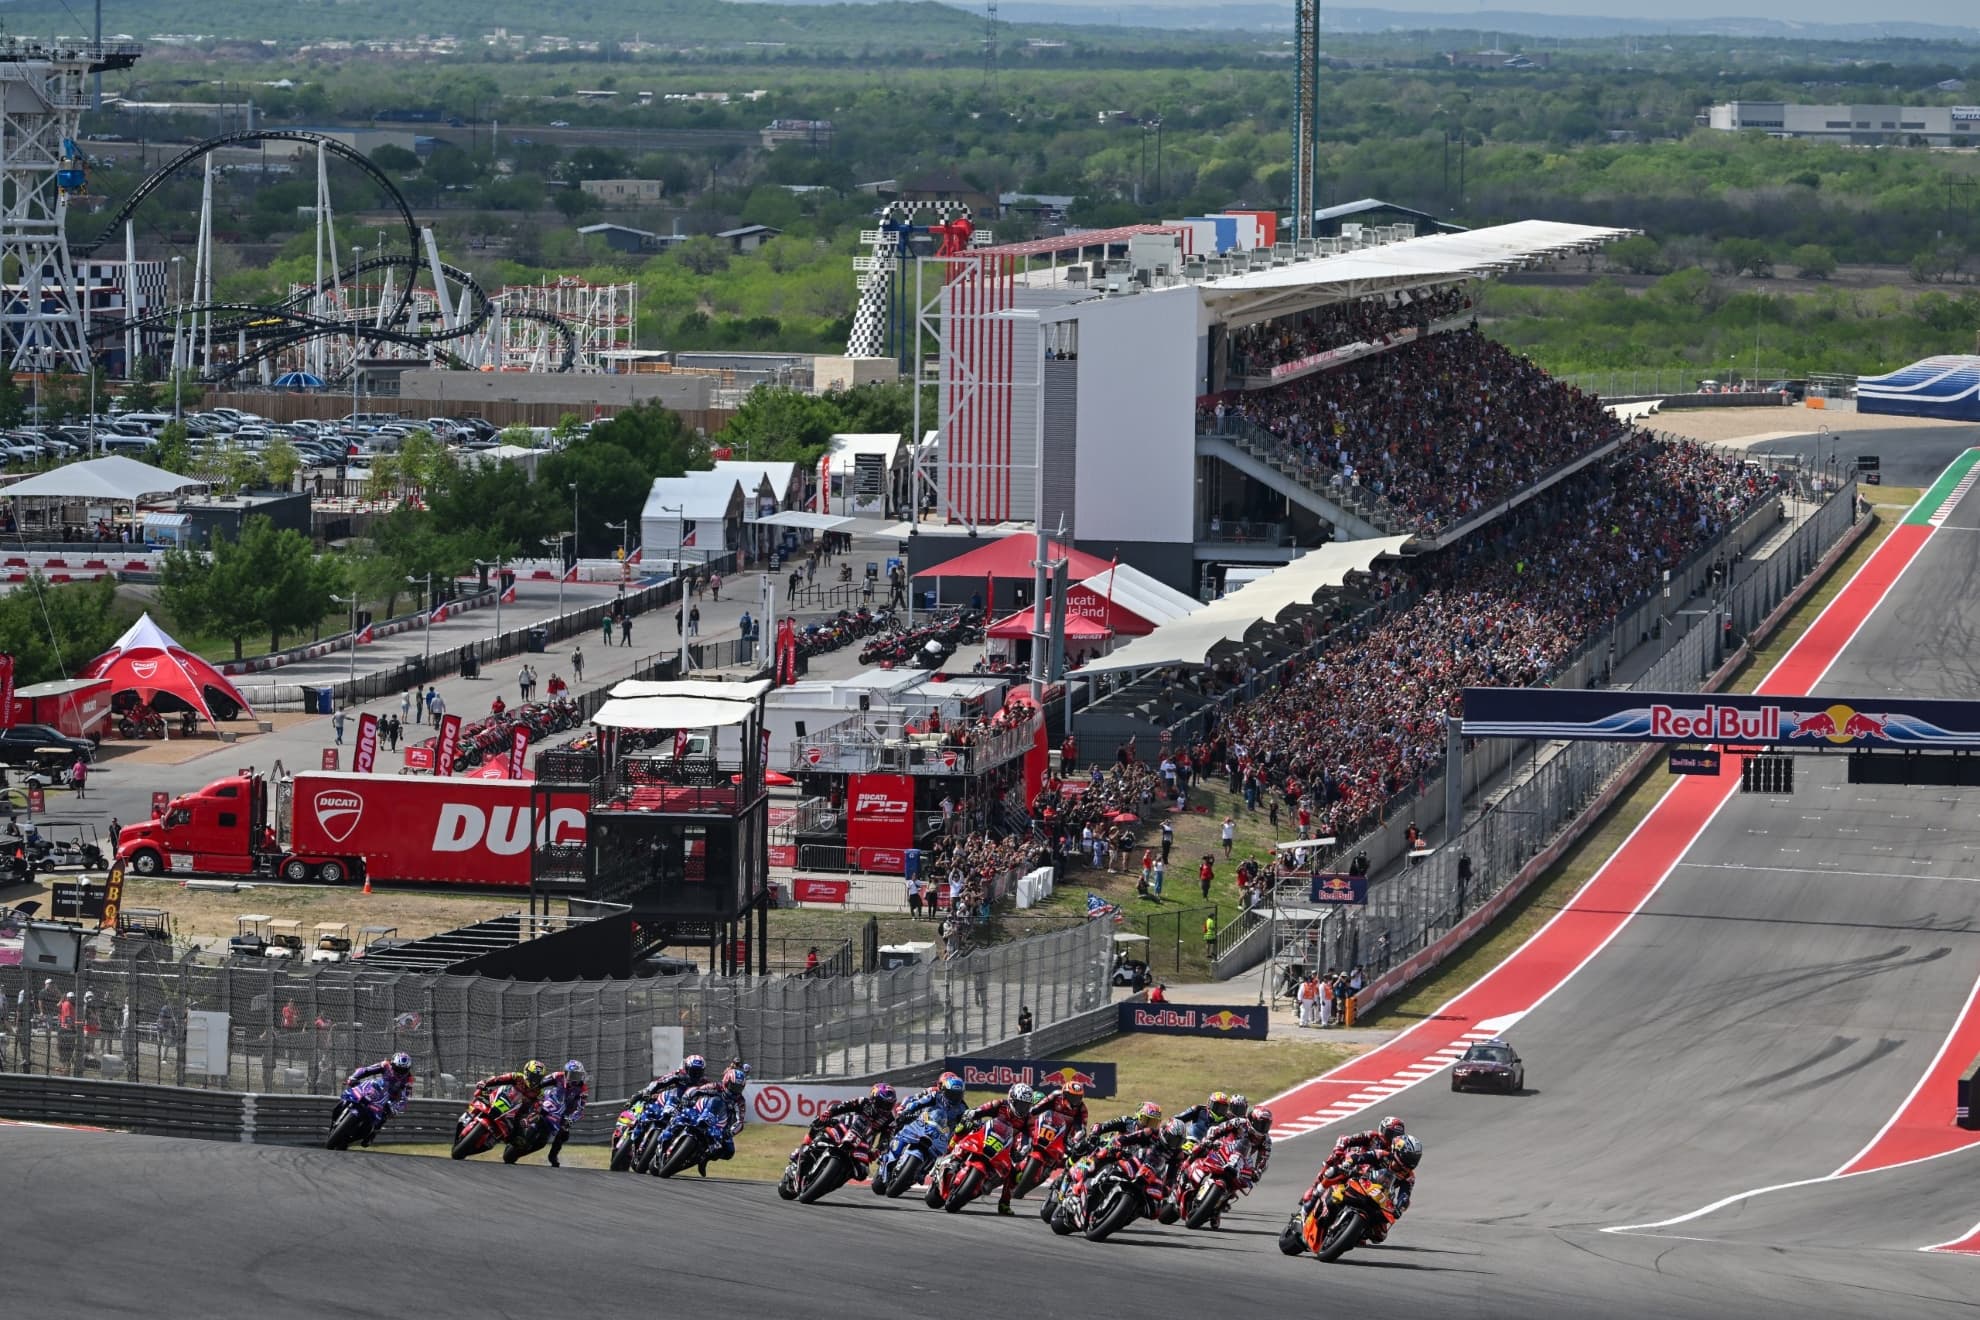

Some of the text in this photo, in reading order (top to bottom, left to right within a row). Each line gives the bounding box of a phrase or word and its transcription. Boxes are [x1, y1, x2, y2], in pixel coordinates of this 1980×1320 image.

[1066, 595, 1096, 606] ucati
[1069, 606, 1104, 617] Island
[1650, 704, 1781, 739] Red Bull
[320, 798, 358, 808] DUCATI
[105, 870, 121, 919] BBQ
[1319, 890, 1354, 900] Red Bull
[1135, 1009, 1196, 1027] Red Bull
[964, 1065, 1033, 1085] Red Bull
[984, 1135, 1004, 1152] 36
